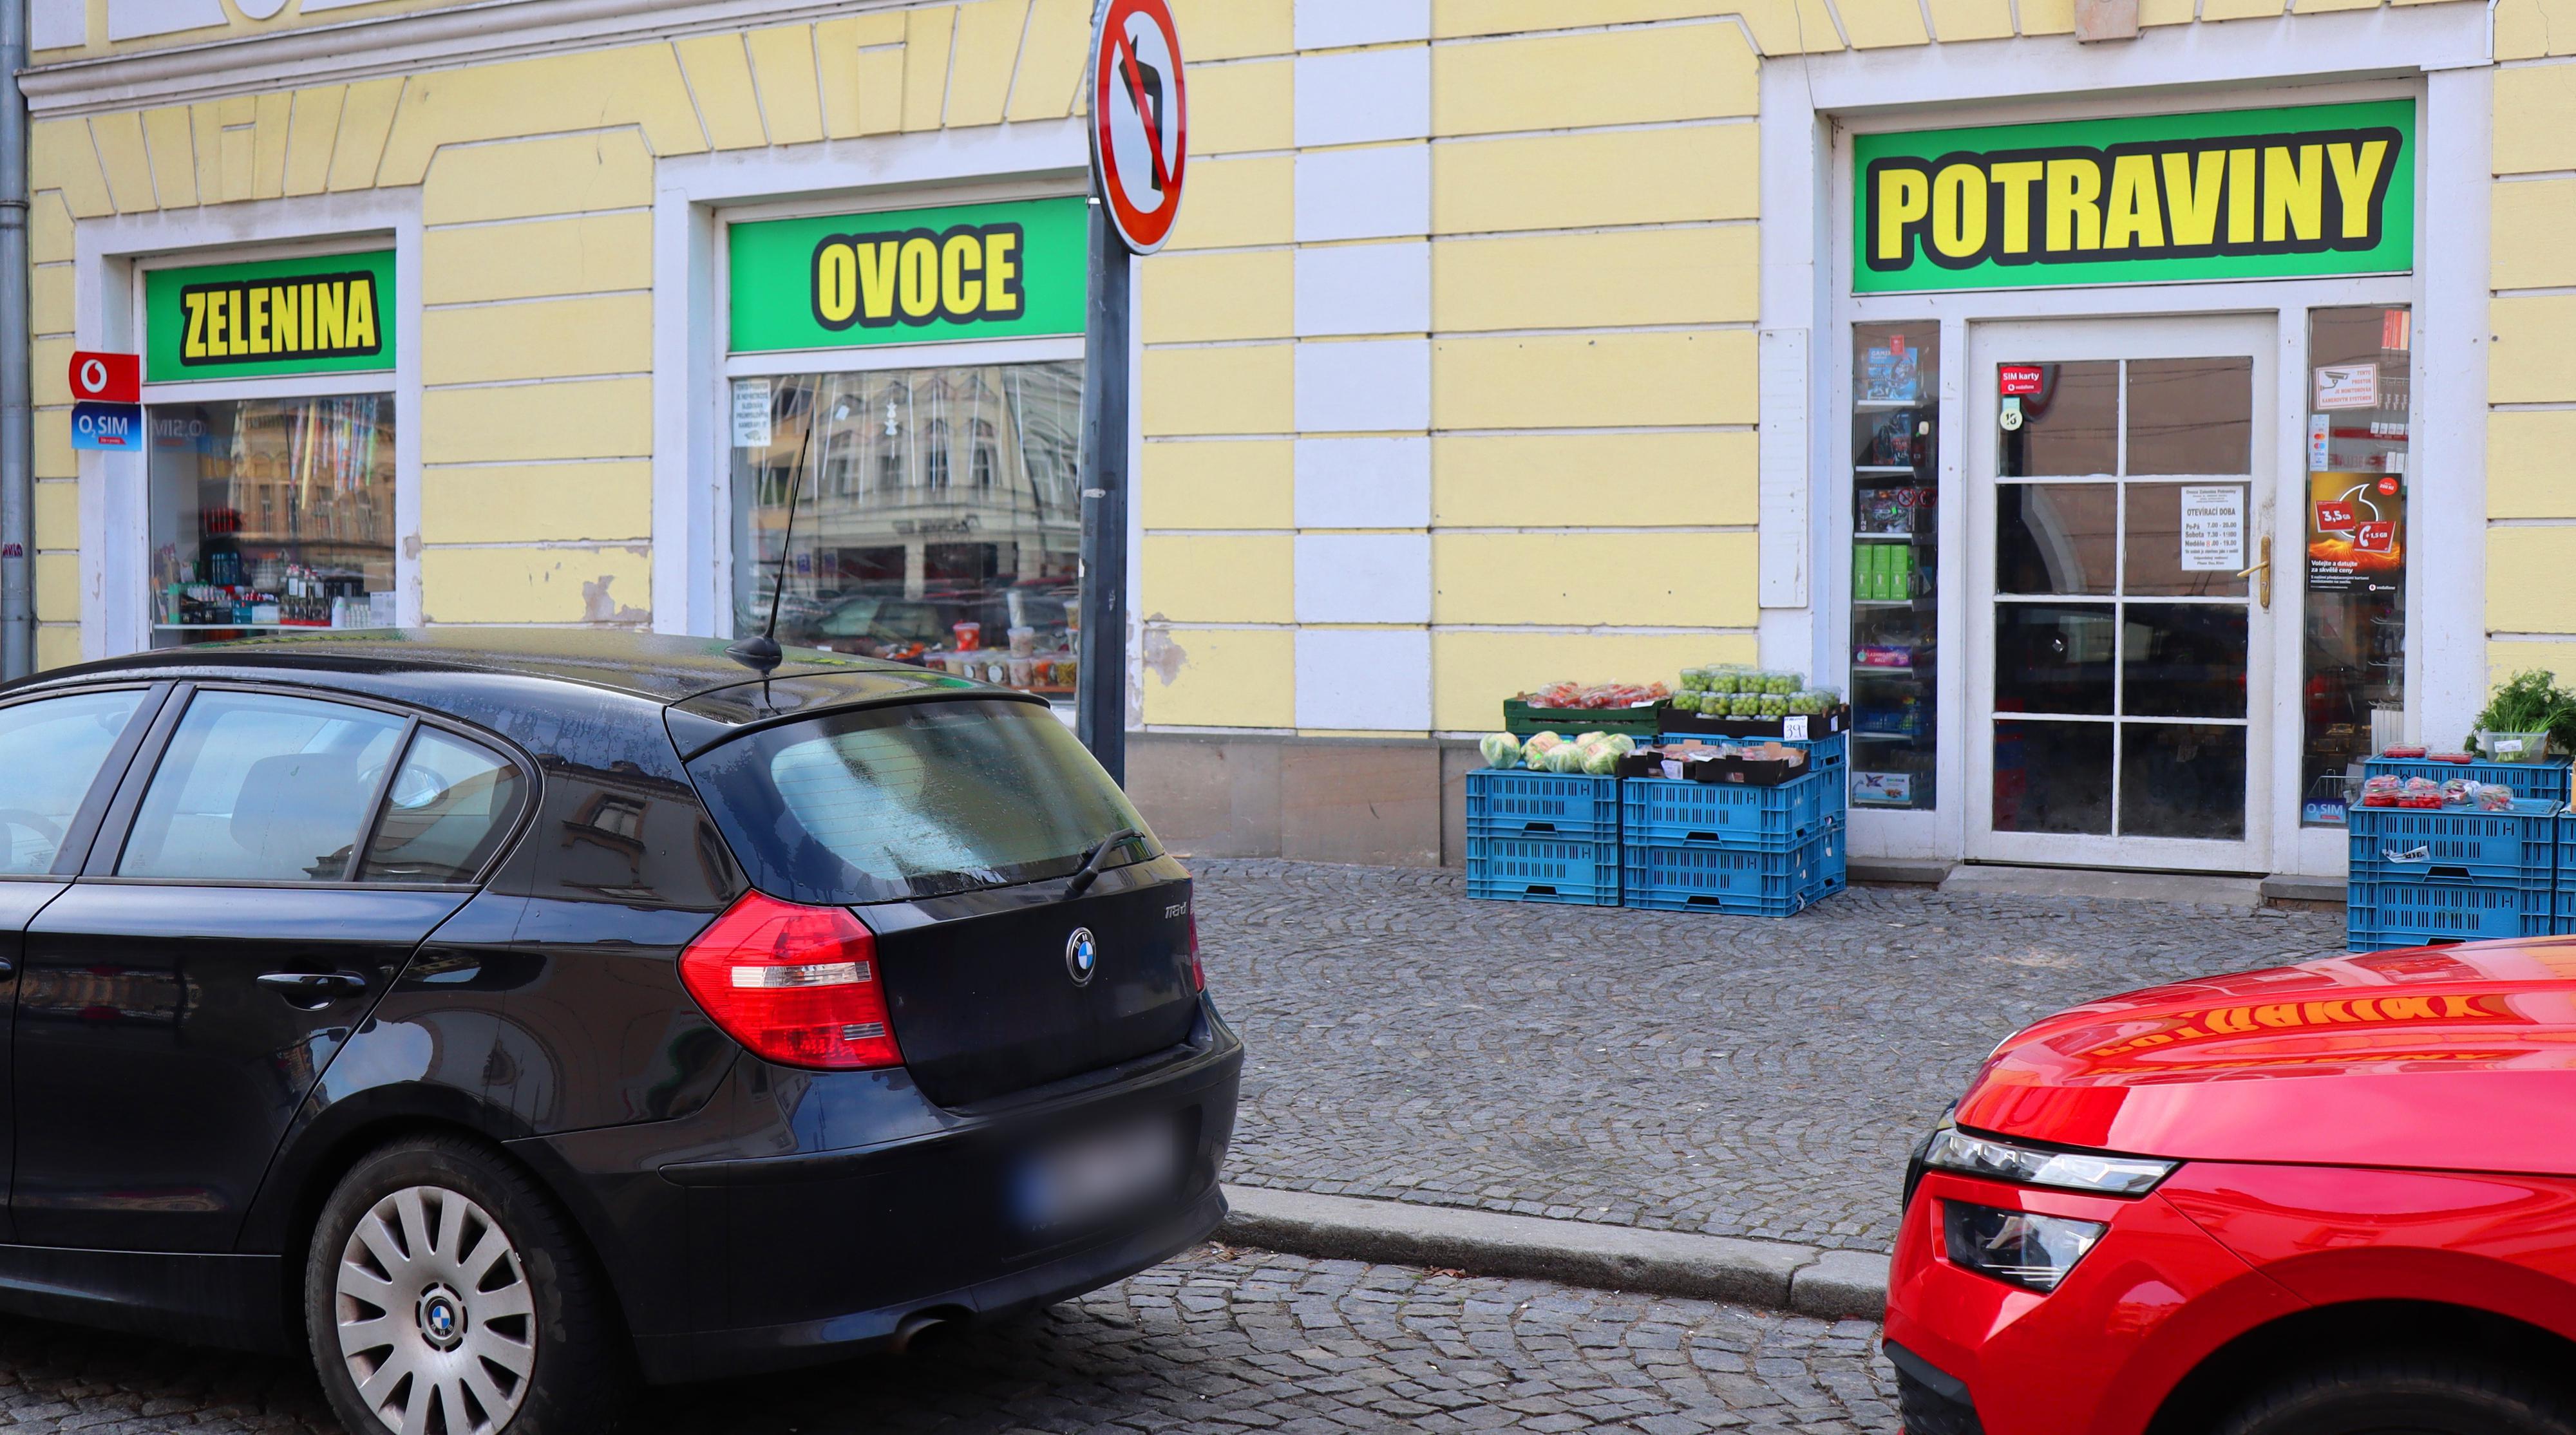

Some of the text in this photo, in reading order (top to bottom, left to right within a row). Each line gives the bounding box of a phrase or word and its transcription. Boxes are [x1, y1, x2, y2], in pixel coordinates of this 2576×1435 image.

[1878, 140, 2388, 259] POTRAVINY
[819, 232, 1017, 322] OVOCE
[185, 279, 376, 359] ZELENINA
[2003, 372, 2040, 381] SIM karty
[98, 416, 128, 435] SIM
[2187, 507, 2218, 516] OTEVÍRACÍ
[2322, 510, 2344, 522] 3,5
[2320, 803, 2344, 815] SIM
